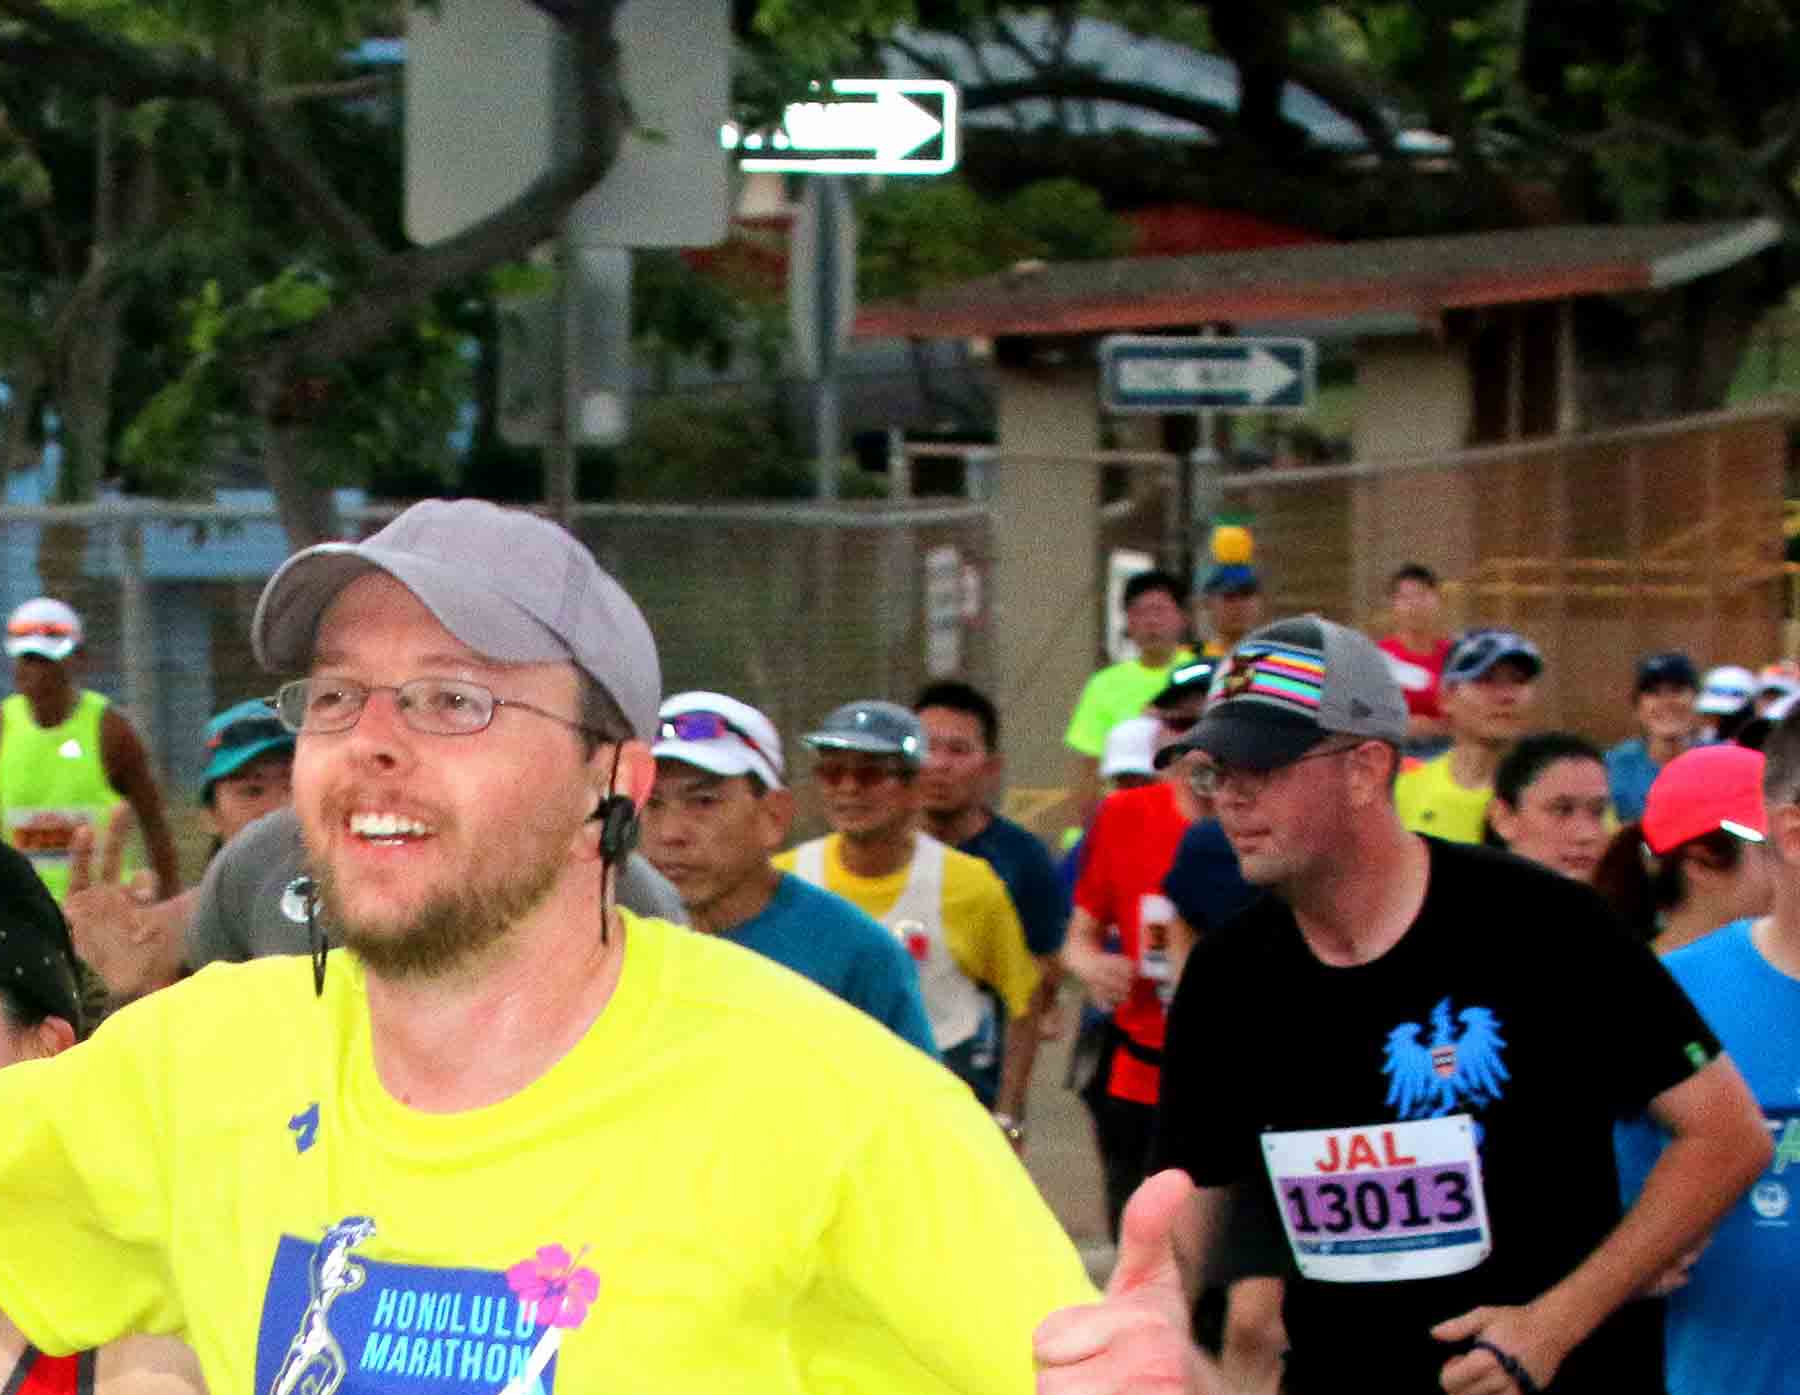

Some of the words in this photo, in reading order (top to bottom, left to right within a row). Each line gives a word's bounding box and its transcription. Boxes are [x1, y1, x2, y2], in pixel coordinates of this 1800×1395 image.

[1314, 1130, 1416, 1172] JAL
[1286, 1171, 1473, 1233] 13013
[372, 1288, 538, 1339] HONOLULU
[360, 1331, 531, 1383] MARATHON
